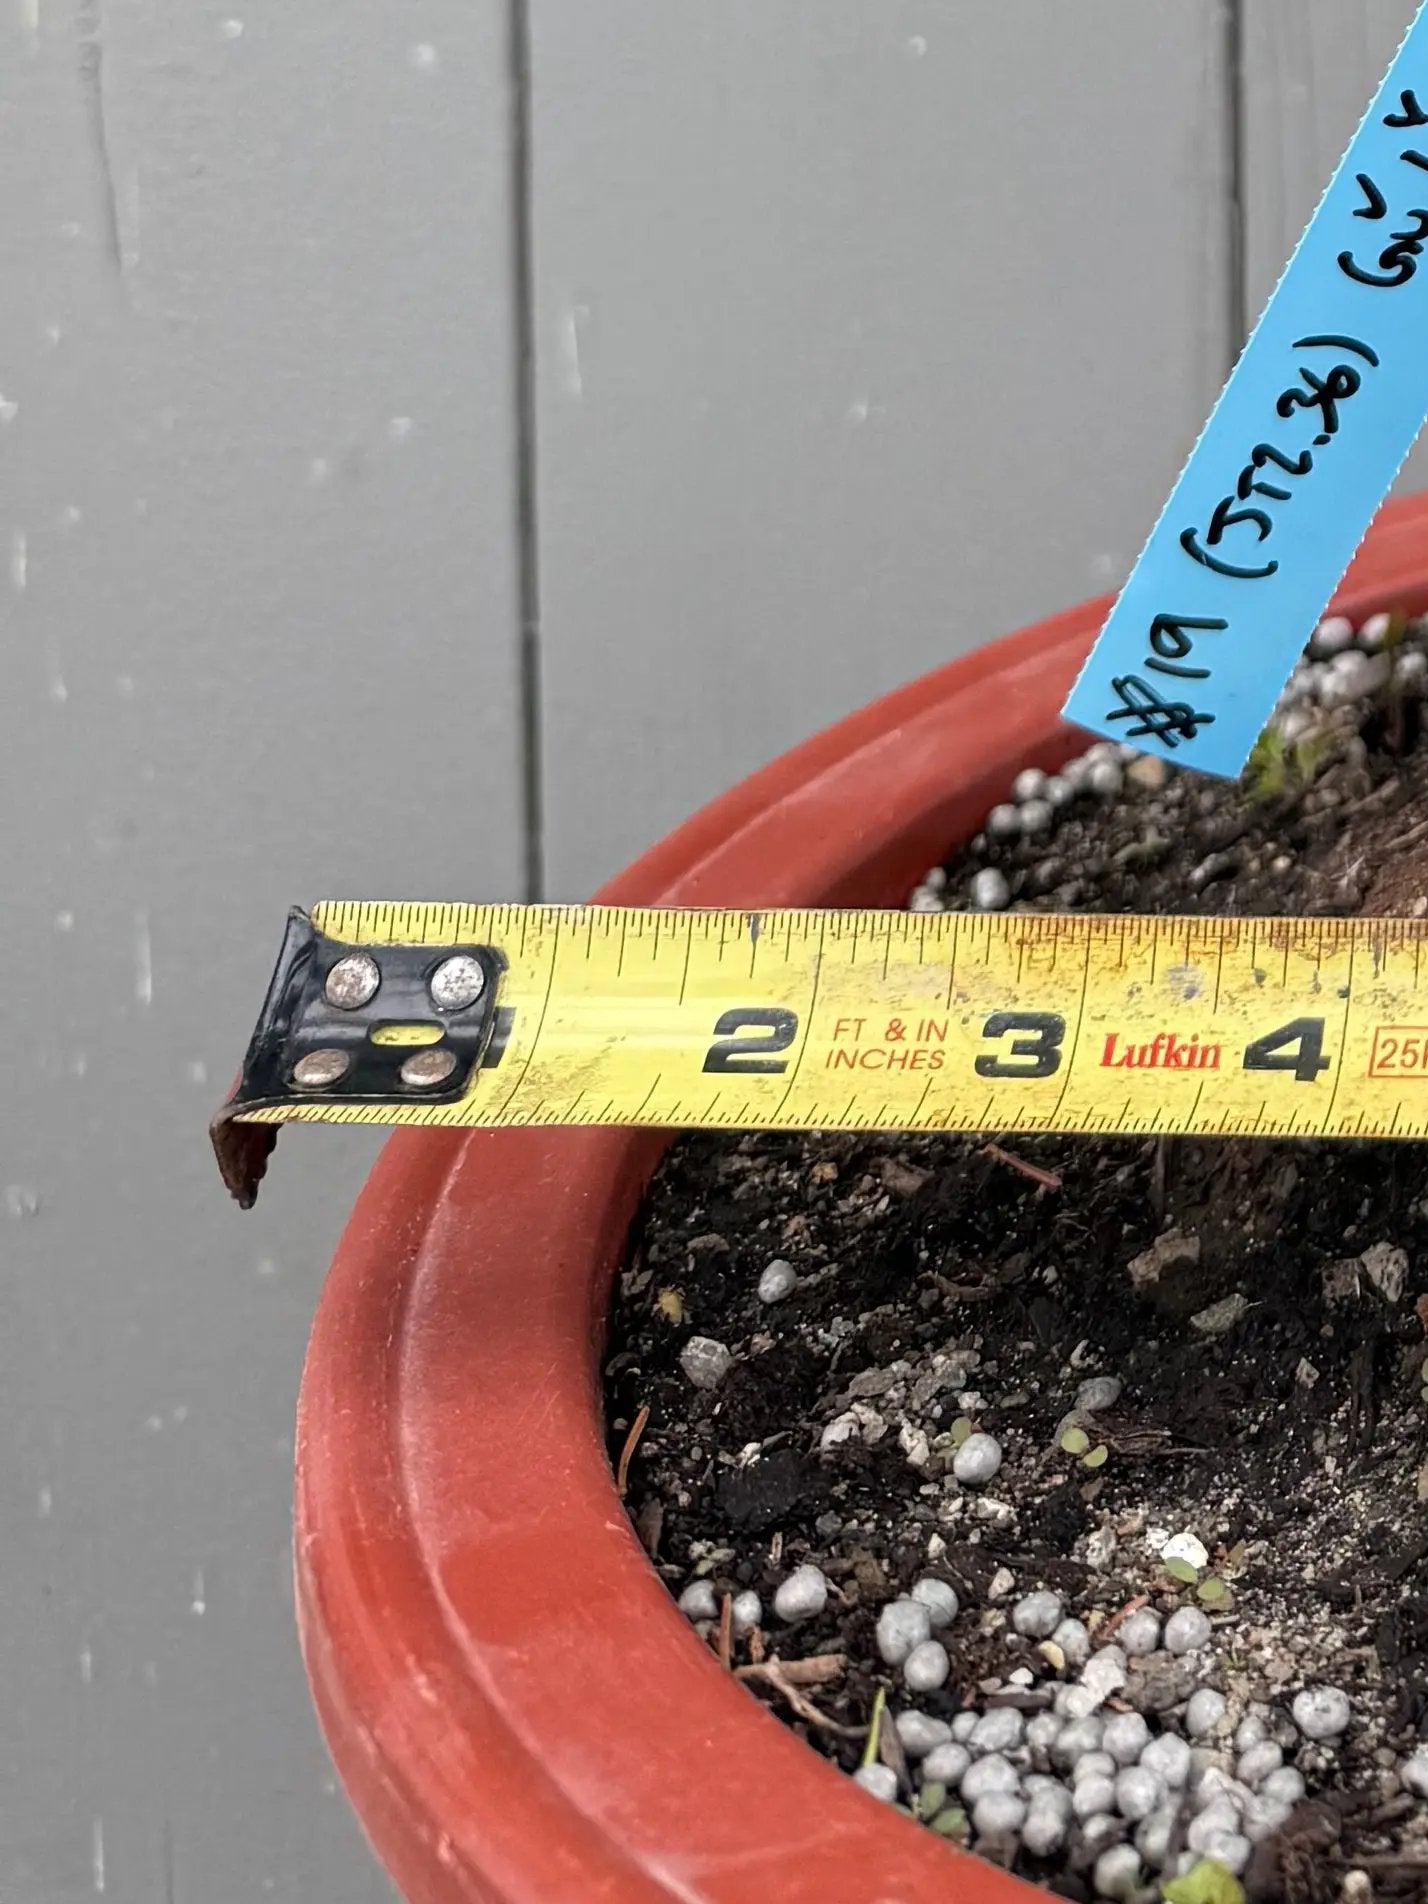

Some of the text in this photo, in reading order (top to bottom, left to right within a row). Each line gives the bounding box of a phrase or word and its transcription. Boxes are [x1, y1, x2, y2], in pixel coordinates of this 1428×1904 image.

[700, 1009, 798, 1074] 2
[833, 1017, 949, 1042] FT & IN
[973, 1012, 1066, 1079] 3
[1099, 1031, 1221, 1070] Lufkin
[1242, 1017, 1332, 1082] 4
[825, 1048, 946, 1070] INCHES
